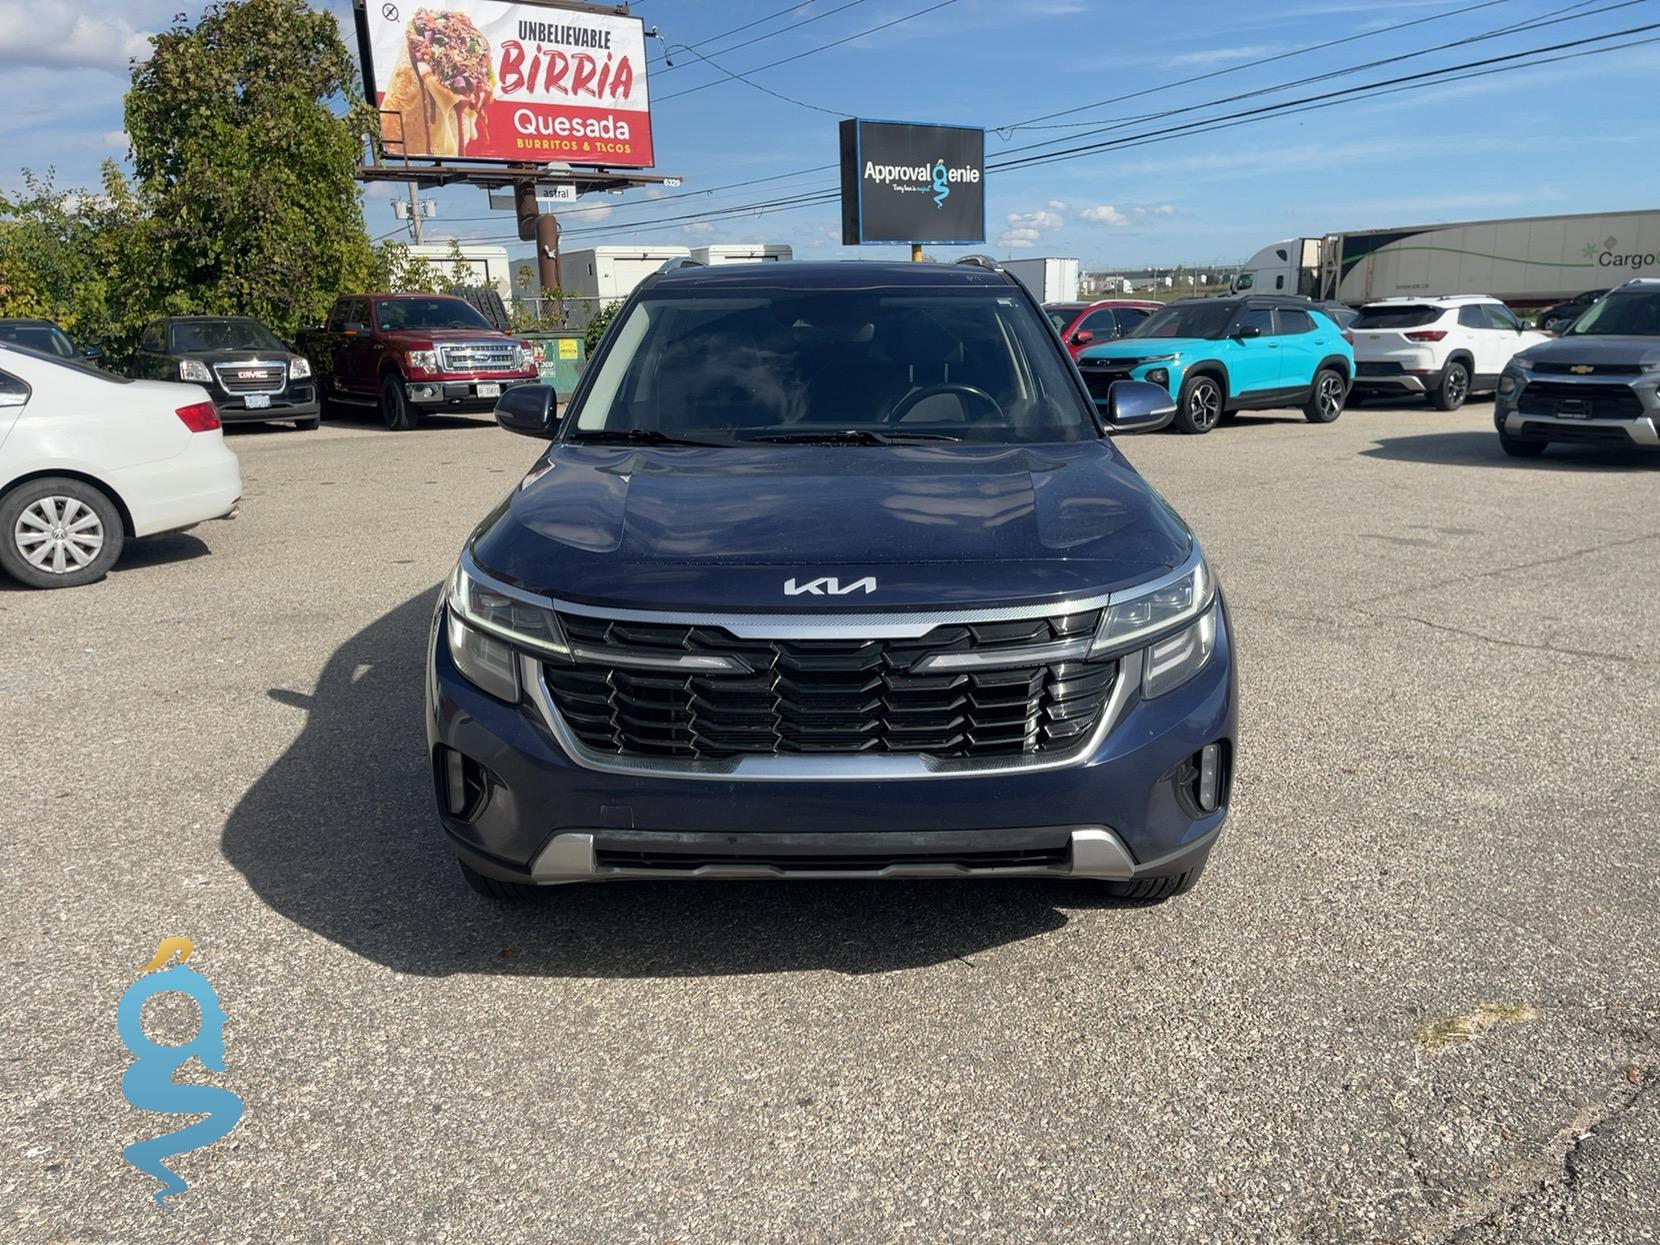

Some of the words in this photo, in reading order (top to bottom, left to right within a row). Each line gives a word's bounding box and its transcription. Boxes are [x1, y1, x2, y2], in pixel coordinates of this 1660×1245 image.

[518, 20, 611, 49] UNBELIEVABLE
[513, 108, 630, 140] Quesada
[516, 138, 578, 151] BURRITOS
[582, 142, 591, 151] &
[595, 142, 631, 153] TACOS
[543, 189, 569, 199] astral
[237, 370, 268, 379] GMC
[784, 576, 877, 596] KIA
